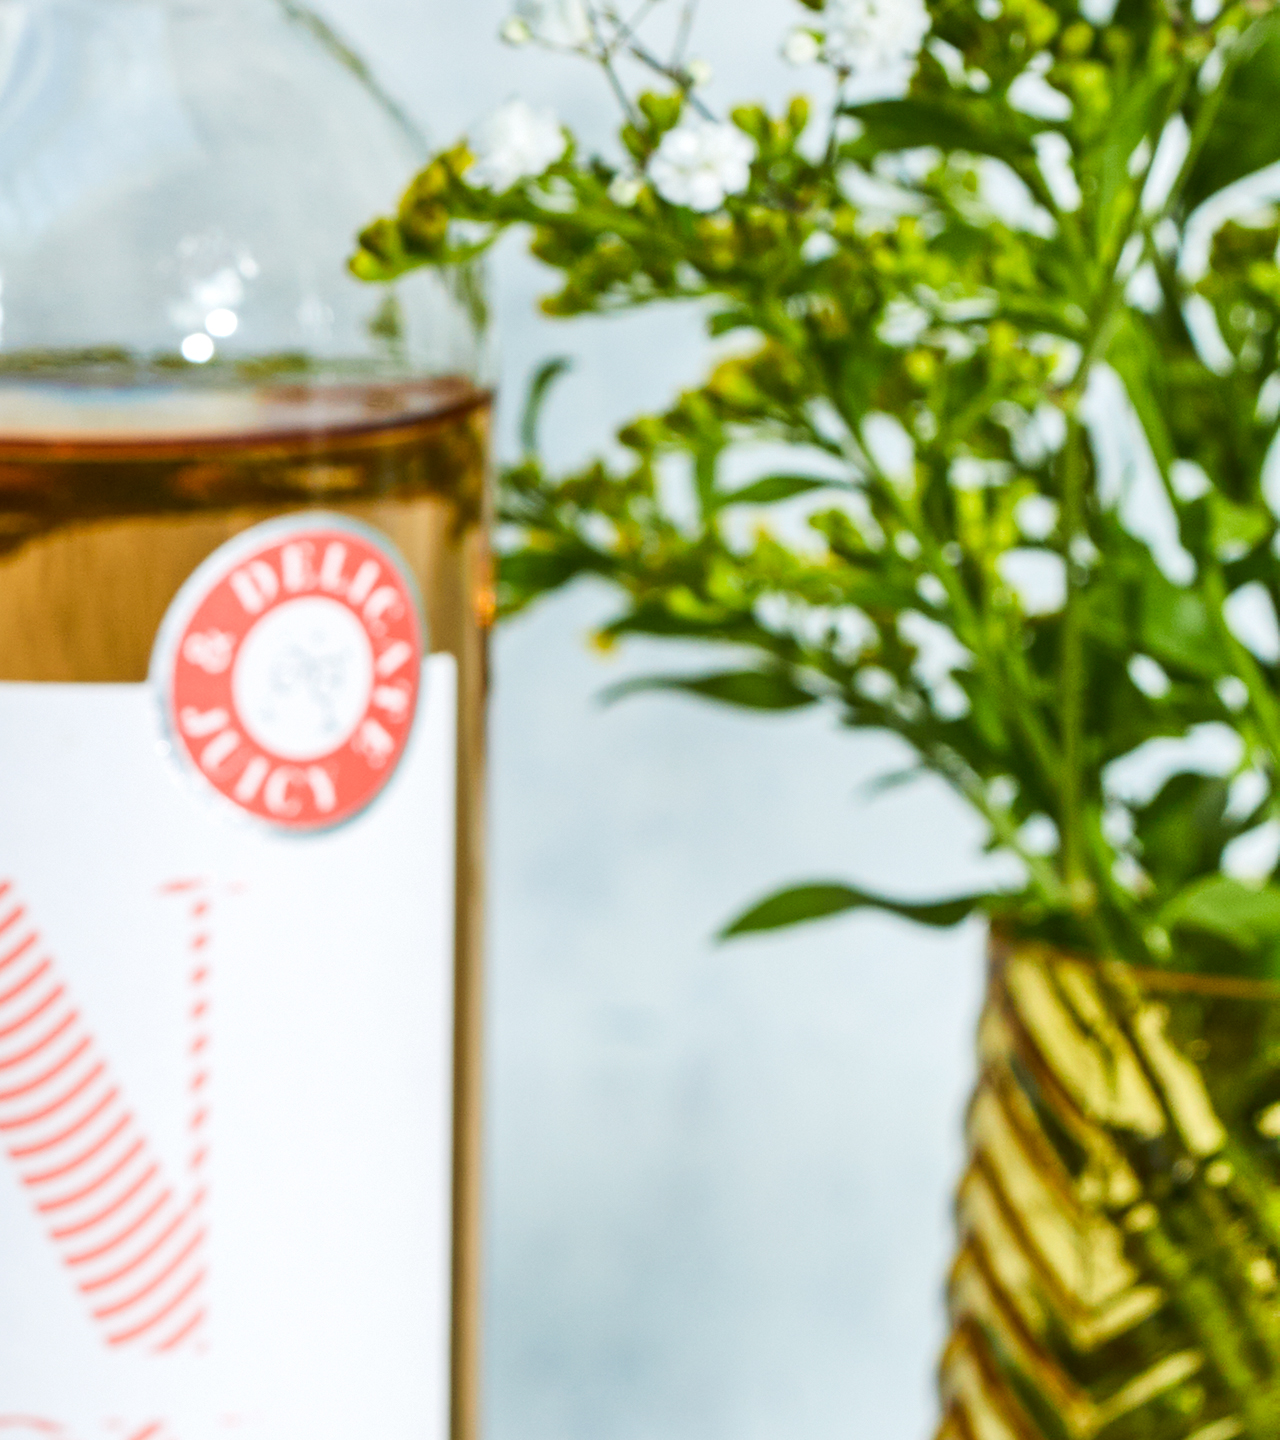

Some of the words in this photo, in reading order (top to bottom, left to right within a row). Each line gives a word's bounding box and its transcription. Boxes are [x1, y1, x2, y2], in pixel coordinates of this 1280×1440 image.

[182, 626, 238, 676] &
[229, 541, 414, 771] DELICATE
[179, 705, 340, 817] JUICY
